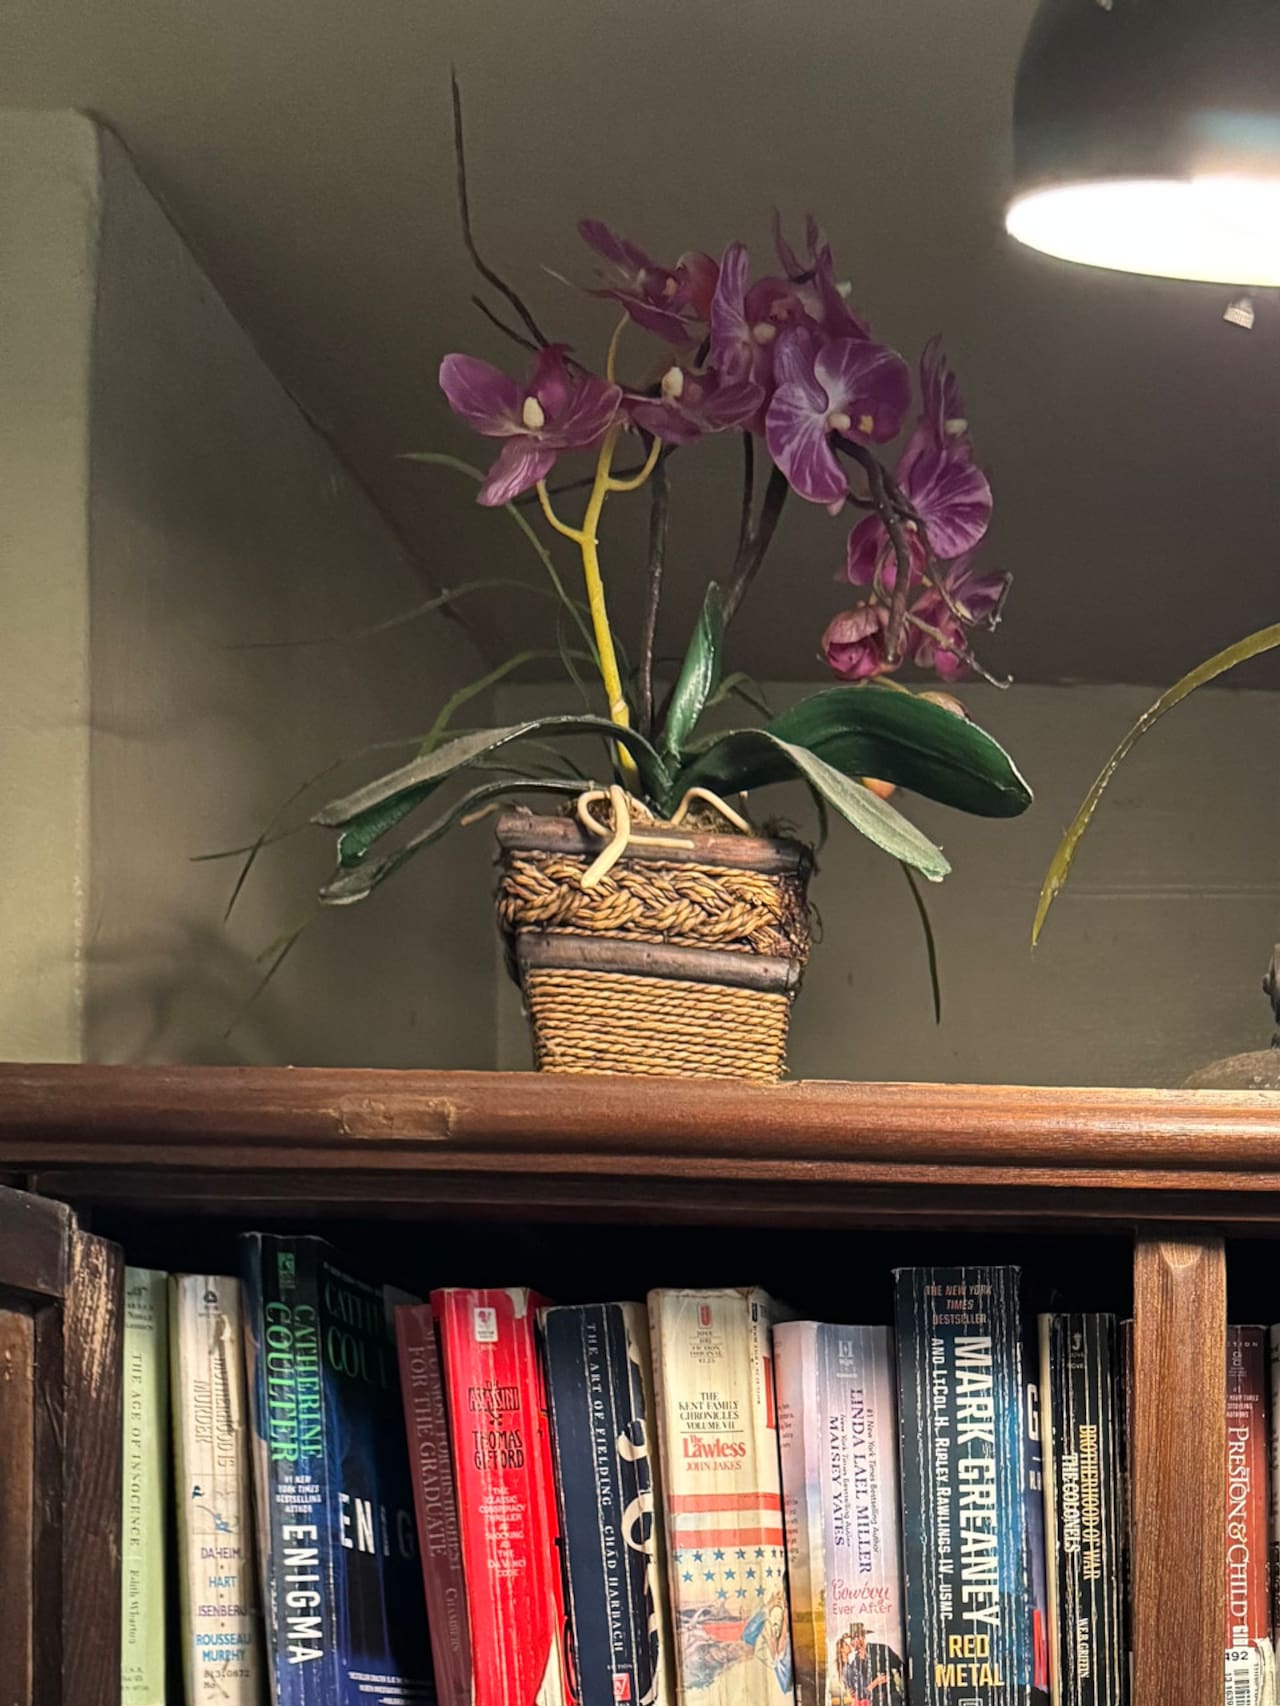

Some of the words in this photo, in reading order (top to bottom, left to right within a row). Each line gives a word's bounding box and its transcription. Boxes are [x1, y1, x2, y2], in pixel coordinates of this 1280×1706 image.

[946, 1299, 974, 1310] TIMES
[587, 1324, 598, 1354] THE
[265, 1302, 299, 1462] COULTER
[589, 1363, 601, 1393] ART
[954, 1336, 995, 1445] MARK
[679, 1402, 702, 1410] KENT
[706, 1401, 739, 1410] FAMILY
[700, 1392, 718, 1400] THE
[594, 1400, 604, 1420] OF
[680, 1411, 739, 1420] CHRONICLES
[851, 1389, 865, 1444] LINDA
[472, 1431, 522, 1449] THOMAS
[683, 1438, 746, 1458] Lawless
[474, 1450, 524, 1469] GIFFORD
[596, 1428, 612, 1506] FIELDING
[686, 1462, 711, 1471] JOHN
[713, 1461, 742, 1471] JAKES
[854, 1454, 869, 1500] LAEL
[604, 1525, 617, 1572] CHAD
[856, 1507, 872, 1574] MILLER
[958, 1458, 1000, 1632] GREANEY
[201, 1547, 241, 1560] DAHEIM
[208, 1576, 237, 1588] HART
[282, 1525, 324, 1664] ENIGMA
[608, 1576, 623, 1653] HARBACH
[202, 1651, 245, 1662] MURPHY
[947, 1634, 989, 1660] RED
[935, 1663, 1004, 1688] METAL
